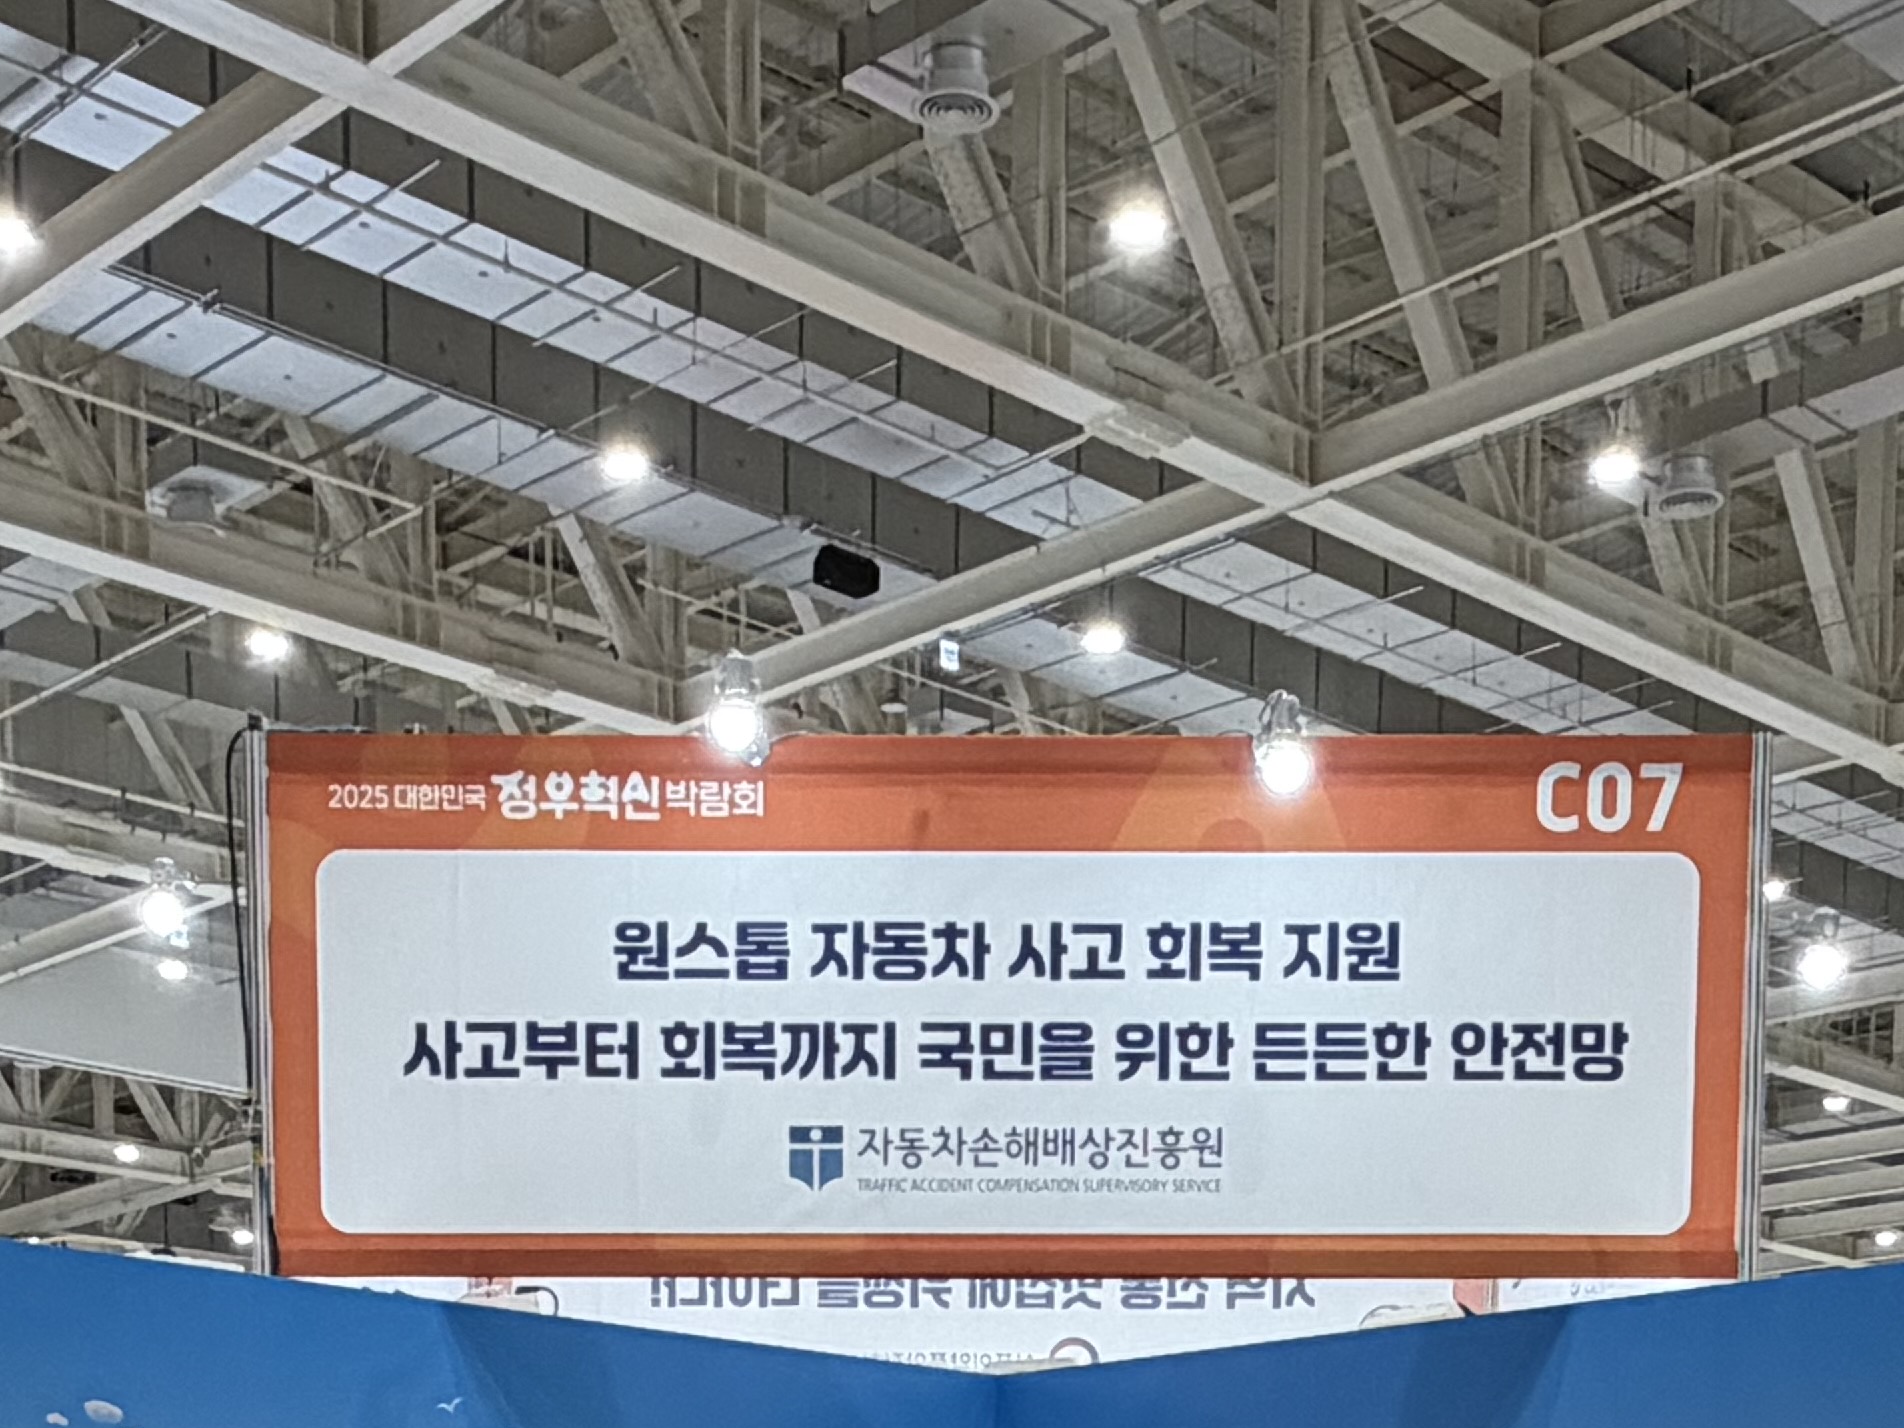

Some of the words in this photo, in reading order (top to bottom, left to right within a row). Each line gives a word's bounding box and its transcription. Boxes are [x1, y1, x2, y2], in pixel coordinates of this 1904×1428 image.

[328, 784, 388, 809] 2025
[393, 784, 486, 810] 대한민국
[665, 781, 764, 817] 박람회
[1536, 762, 1684, 835] C07
[612, 920, 788, 983] 원스톱
[808, 920, 990, 983] 자동차
[1010, 920, 1124, 983] 사고
[1146, 920, 1263, 983] 회복
[1283, 920, 1401, 983] 지원
[402, 1021, 643, 1083] 사고부터
[660, 1021, 898, 1083] 회복까지
[917, 1021, 1094, 1083] 국민을
[1114, 1021, 1234, 1083] 위한
[1253, 1021, 1431, 1083] 든든한
[1449, 1021, 1629, 1083] 안전망
[857, 1125, 1224, 1170] 자동차손해배상진흥원
[858, 1177, 907, 1194] TRAFFIC
[909, 1177, 974, 1194] ACCIDENT
[976, 1177, 1080, 1194] COMPENSATION
[1083, 1177, 1168, 1194] SUPERVISORY
[1171, 1177, 1223, 1194] SERVICE
